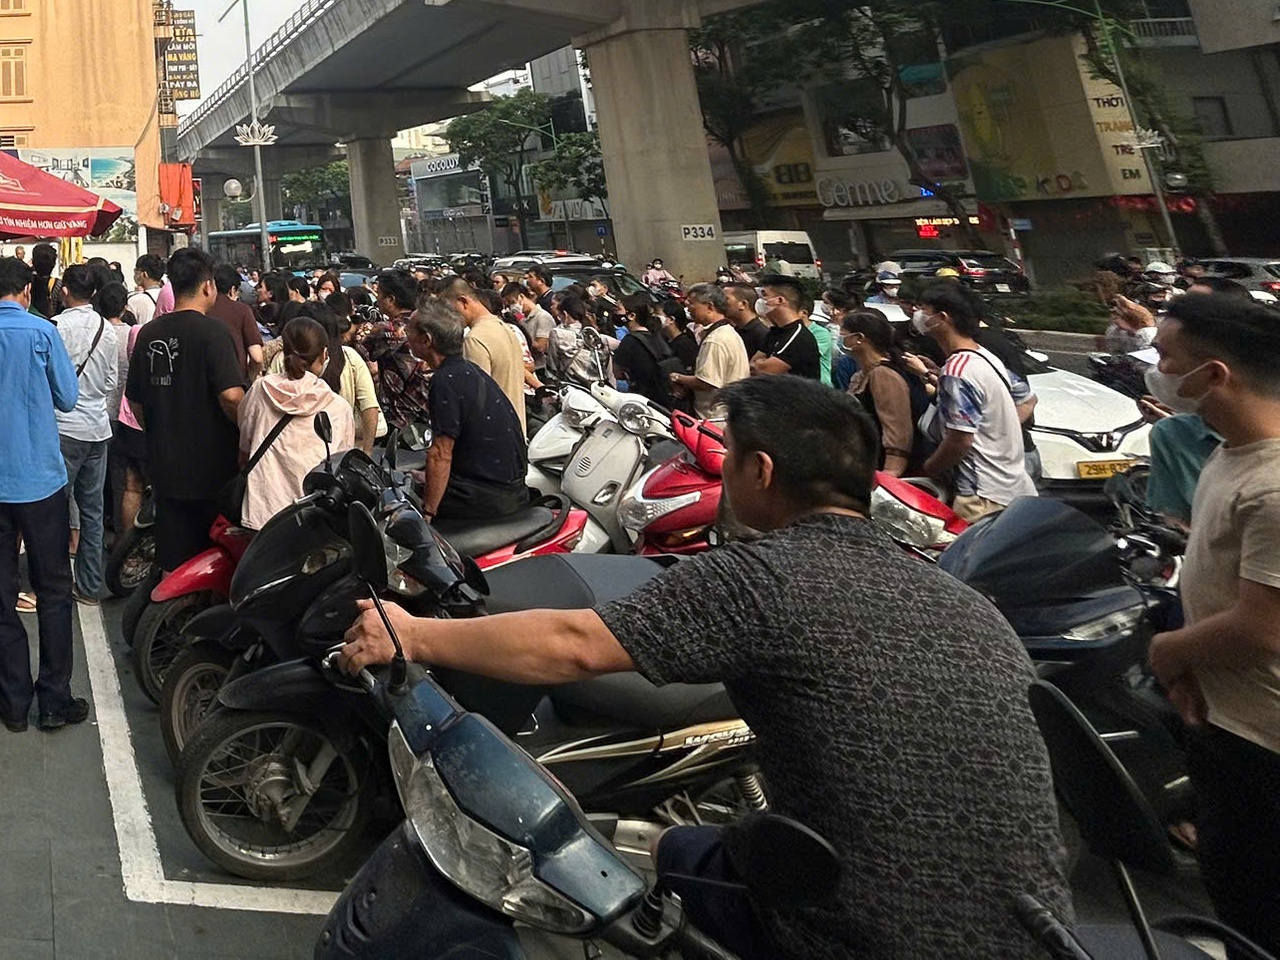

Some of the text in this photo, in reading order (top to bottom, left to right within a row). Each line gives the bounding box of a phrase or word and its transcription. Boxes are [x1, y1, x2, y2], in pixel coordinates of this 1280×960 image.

[167, 42, 196, 51] LÀM MỚI
[179, 52, 197, 62] VÀNG
[1121, 169, 1141, 180] EM
[3, 217, 15, 227] TÍN
[15, 218, 37, 230] NHIỆM
[39, 220, 53, 230] HƠN
[683, 225, 714, 240] P334
[380, 237, 396, 245] P333
